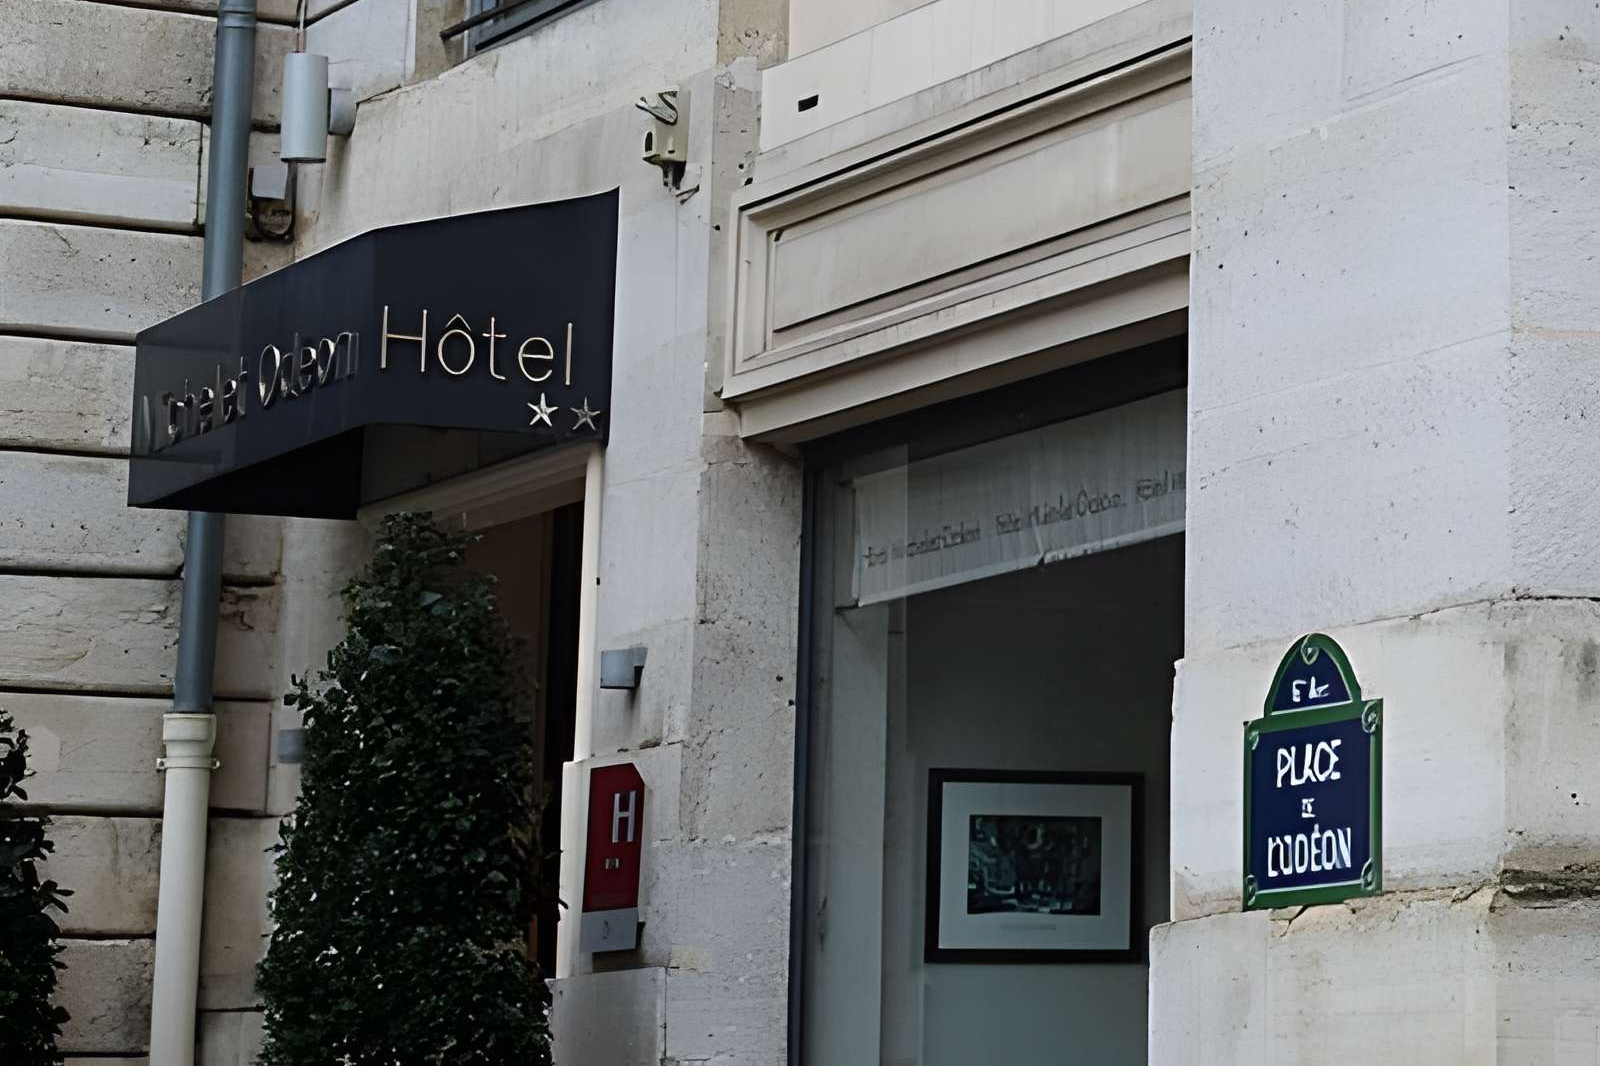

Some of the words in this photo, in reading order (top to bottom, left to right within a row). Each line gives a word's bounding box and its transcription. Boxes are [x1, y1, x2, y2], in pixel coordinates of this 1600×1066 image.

[379, 304, 573, 387] Hôtel
[1276, 739, 1342, 788] PLACE
[611, 789, 637, 844] H
